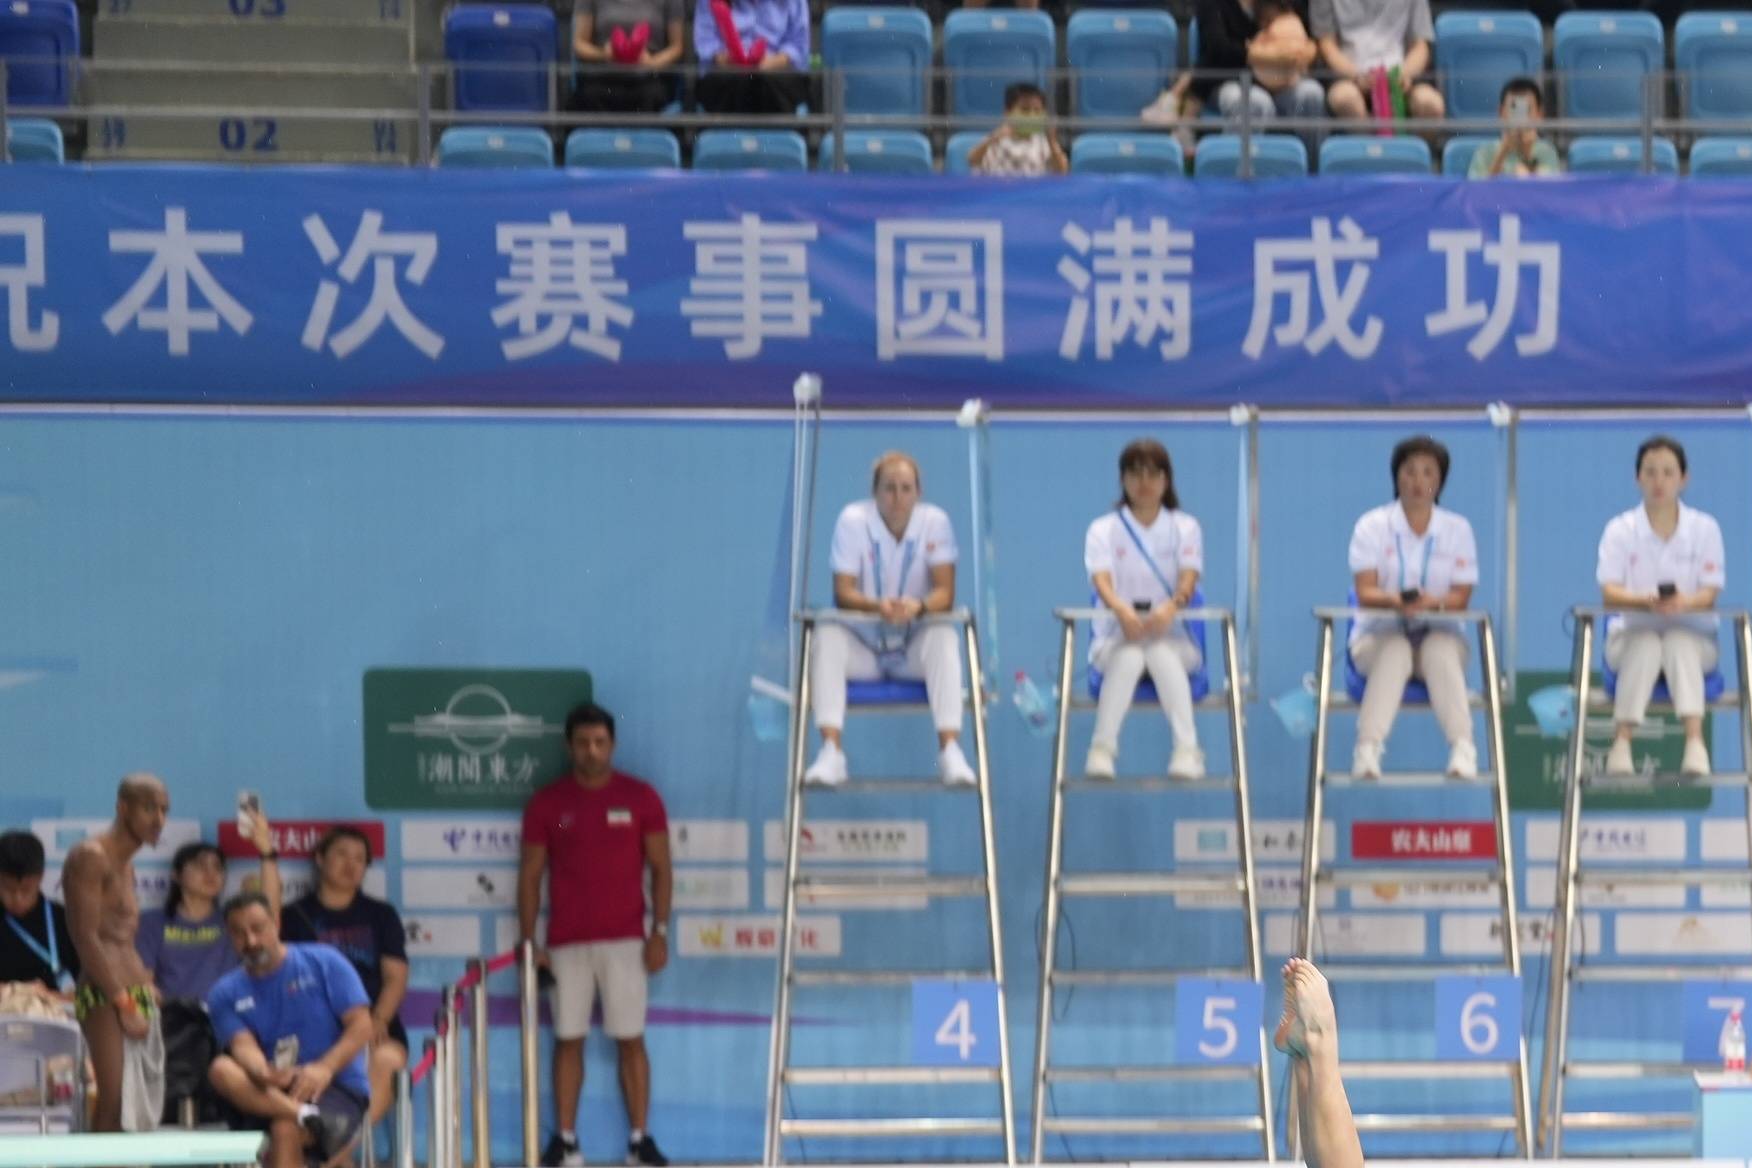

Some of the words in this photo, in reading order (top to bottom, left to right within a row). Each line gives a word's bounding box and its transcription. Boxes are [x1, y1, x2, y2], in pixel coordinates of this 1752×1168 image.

[219, 117, 279, 151] 02
[934, 999, 977, 1060] 4
[1199, 996, 1239, 1058] 5
[1459, 992, 1498, 1055] 6
